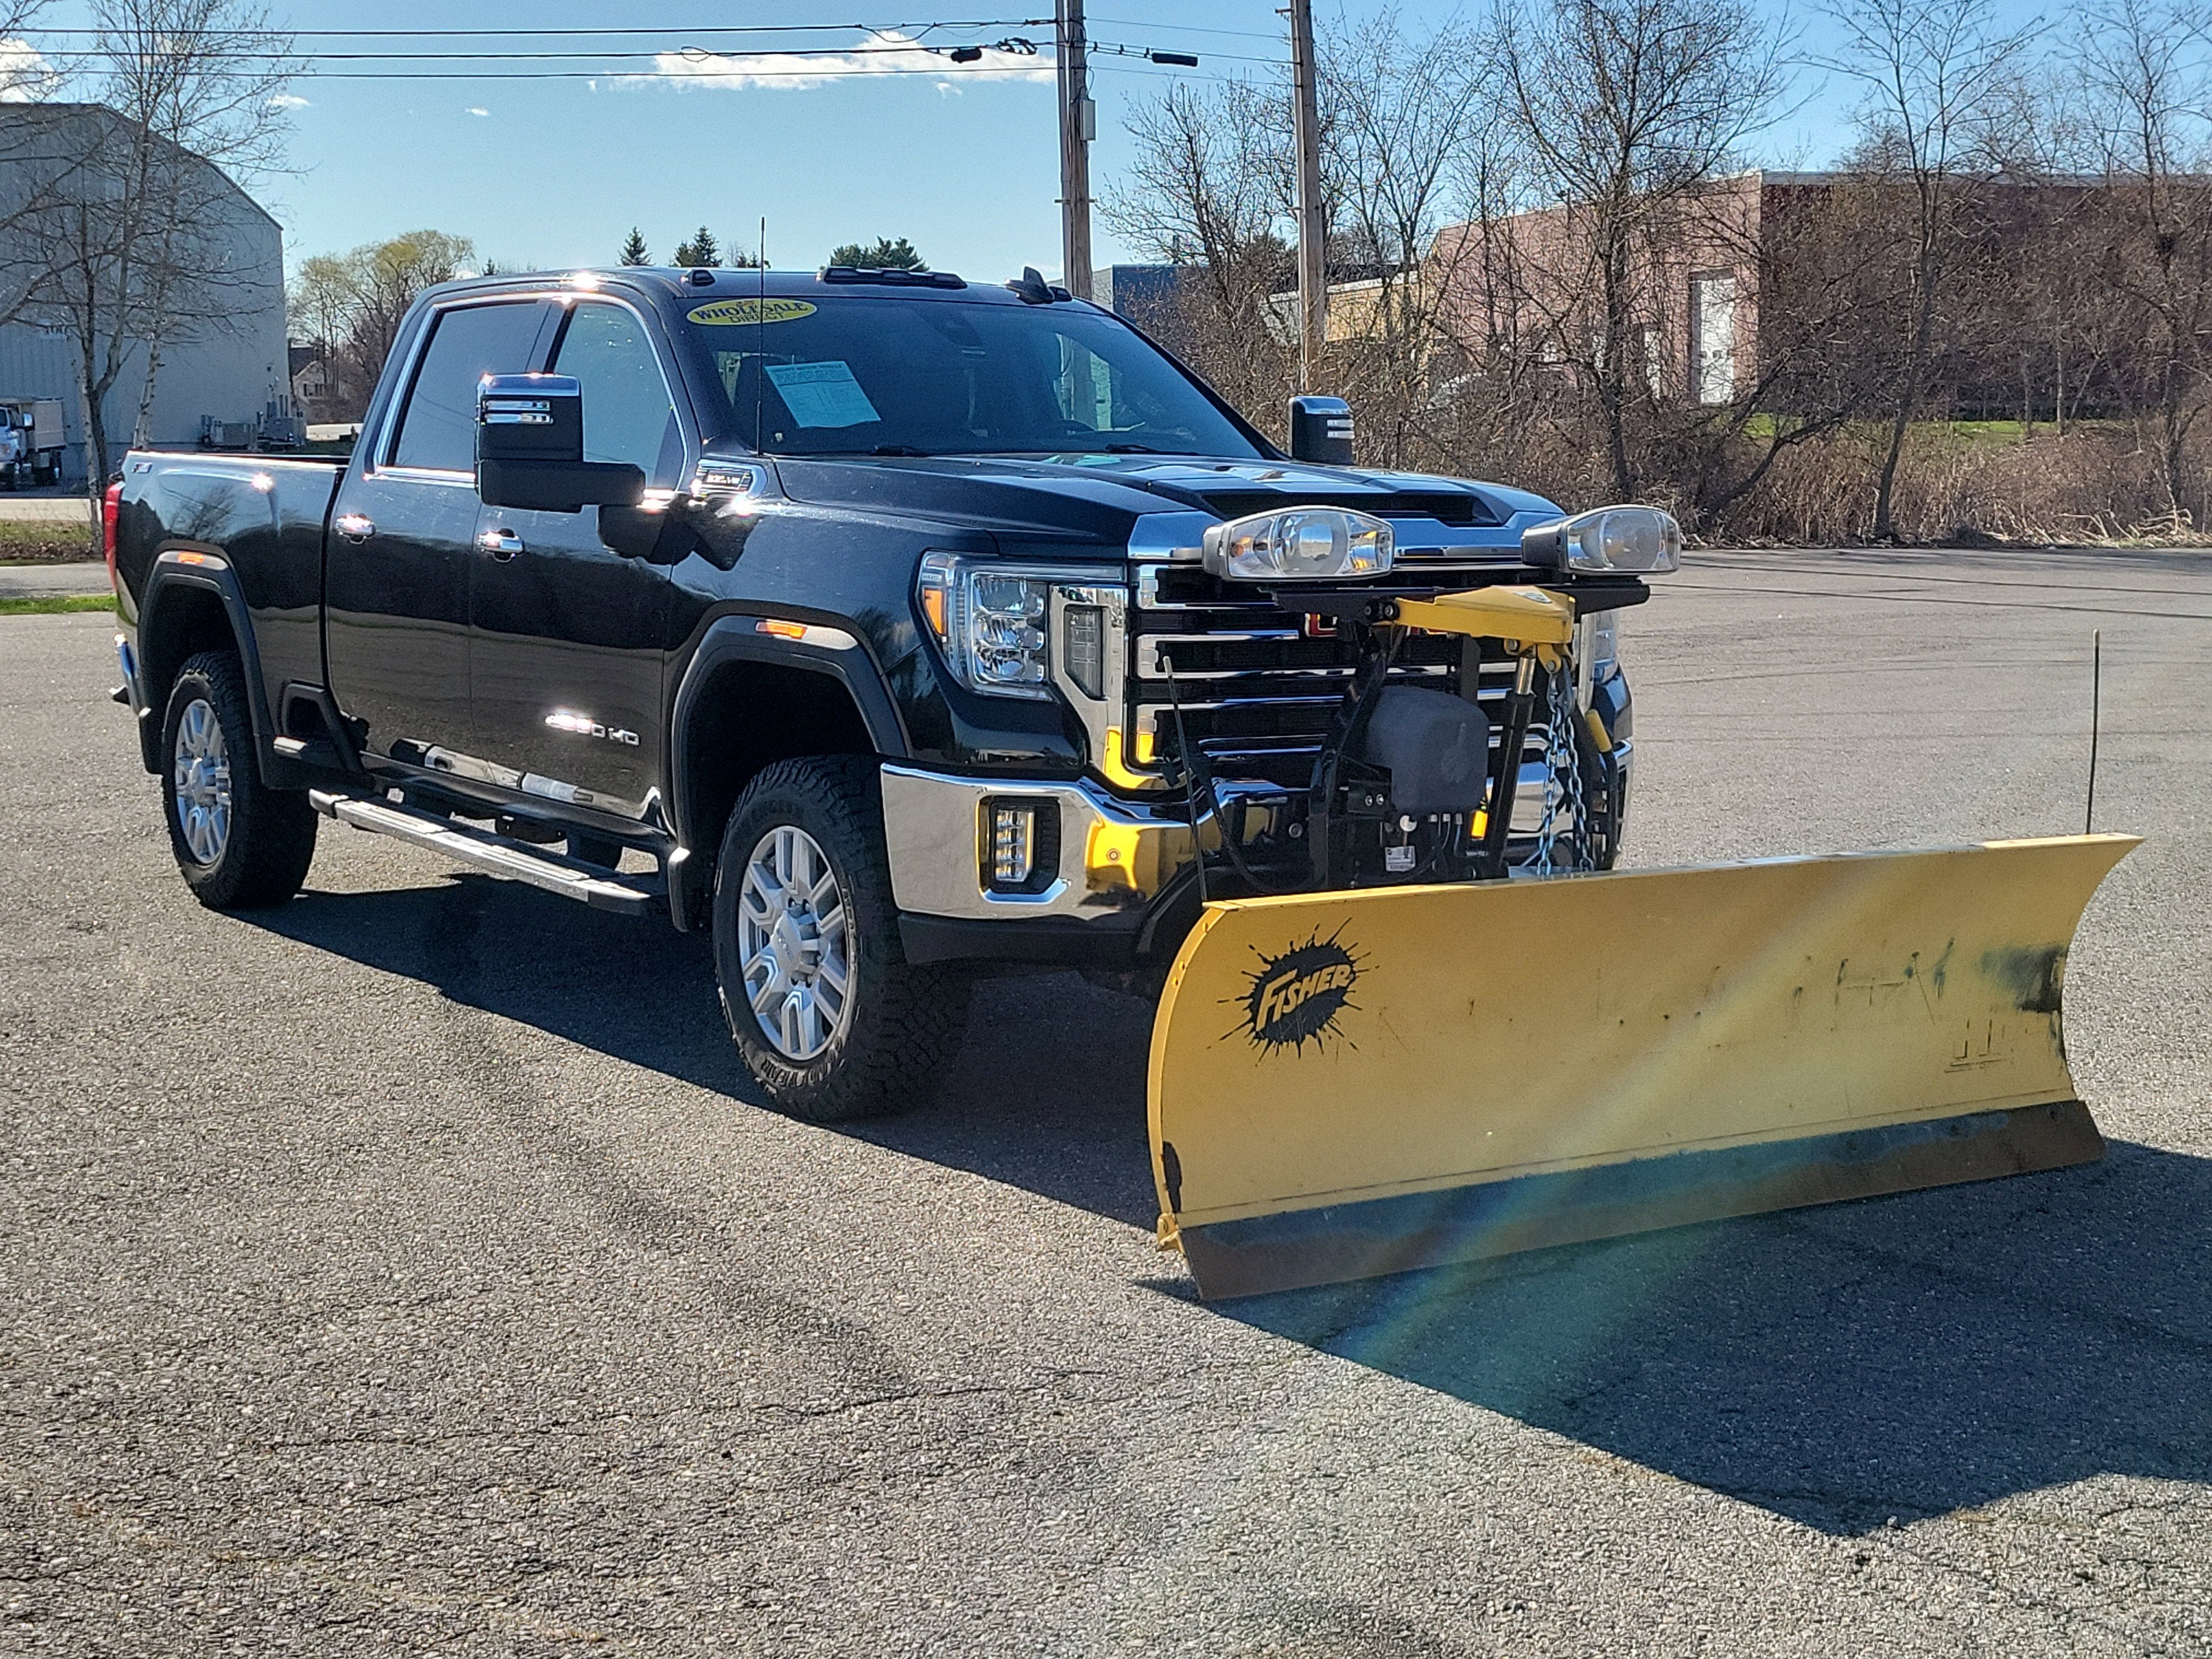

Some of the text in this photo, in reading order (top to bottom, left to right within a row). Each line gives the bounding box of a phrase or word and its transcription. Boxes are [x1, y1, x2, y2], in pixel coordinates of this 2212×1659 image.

[693, 302, 808, 320] WHOLESALE
[729, 311, 785, 323] DIRECT
[1255, 963, 1352, 1032] FISHER
